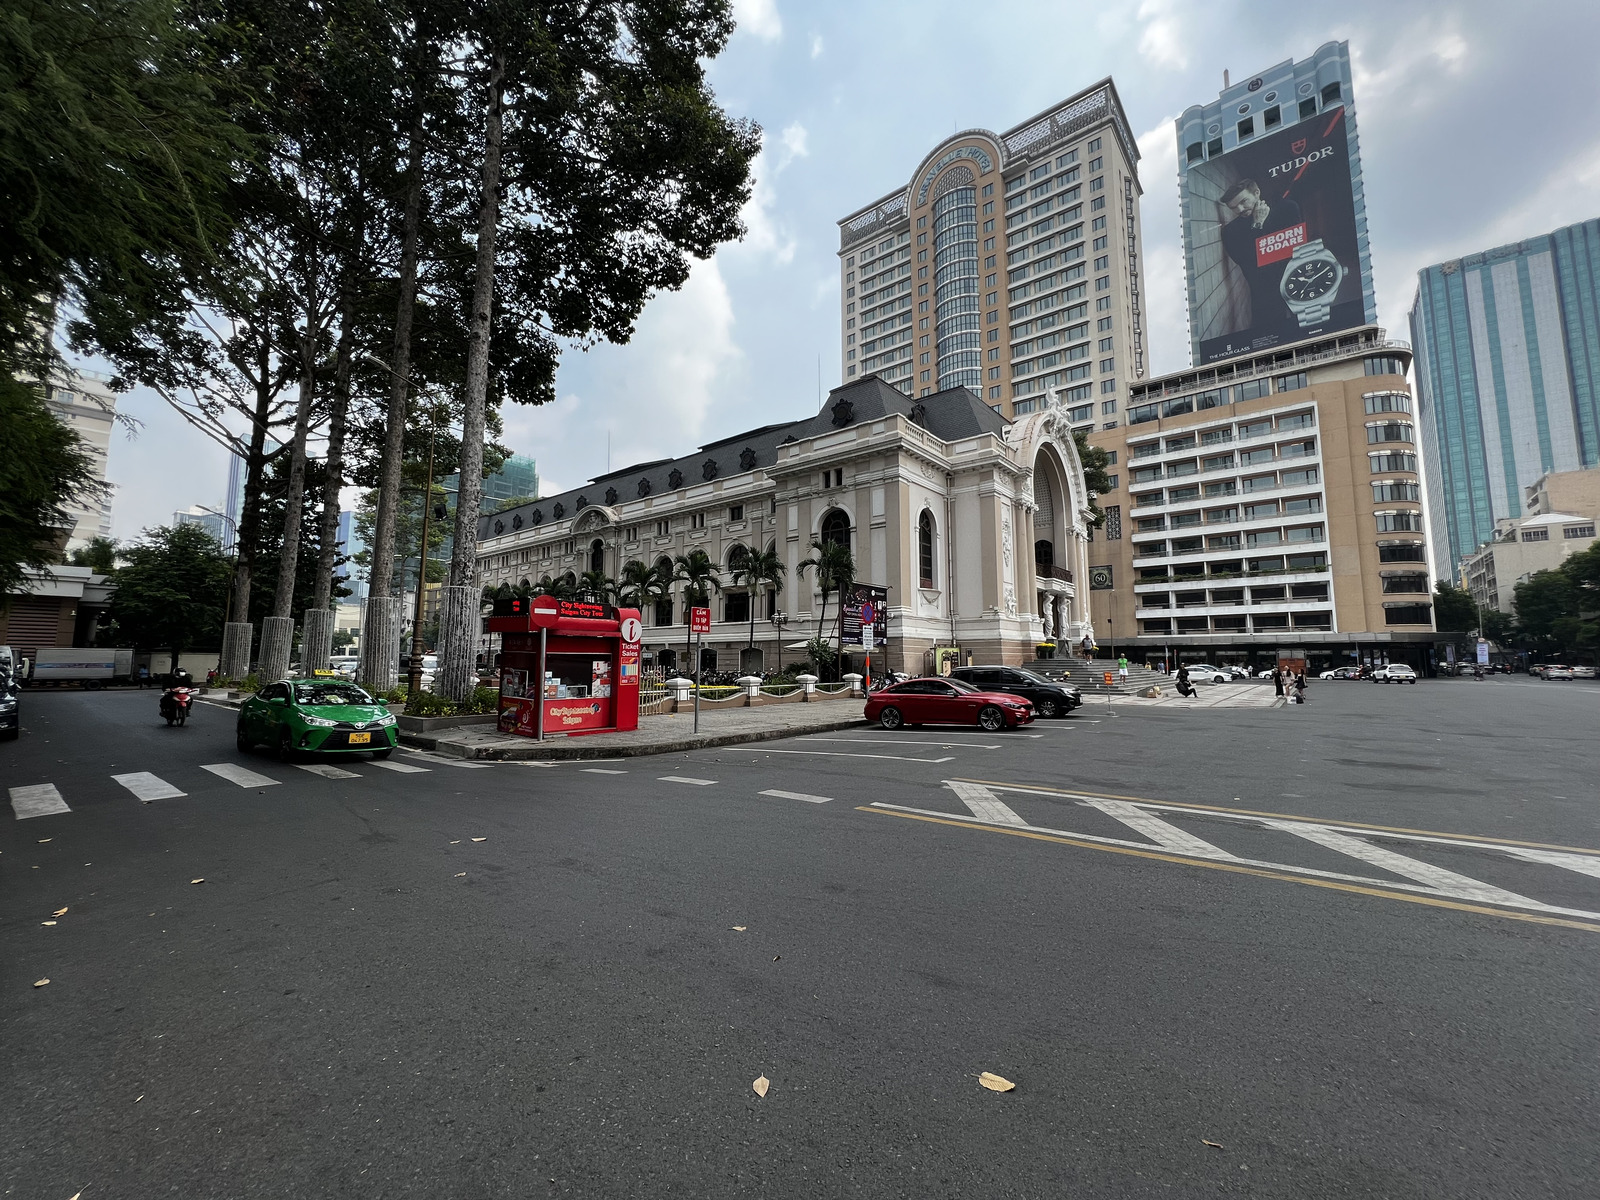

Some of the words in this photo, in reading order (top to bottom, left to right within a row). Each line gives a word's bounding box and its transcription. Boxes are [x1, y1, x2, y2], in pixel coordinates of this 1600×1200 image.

[967, 148, 991, 174] HOTEL
[1268, 145, 1335, 178] TUDOR
[1259, 225, 1304, 247] #BORN
[1259, 234, 1304, 255] TODARE
[1305, 263, 1313, 271] 12
[1234, 345, 1250, 354] GLASS
[1095, 574, 1106, 582] 60
[560, 601, 573, 609] City
